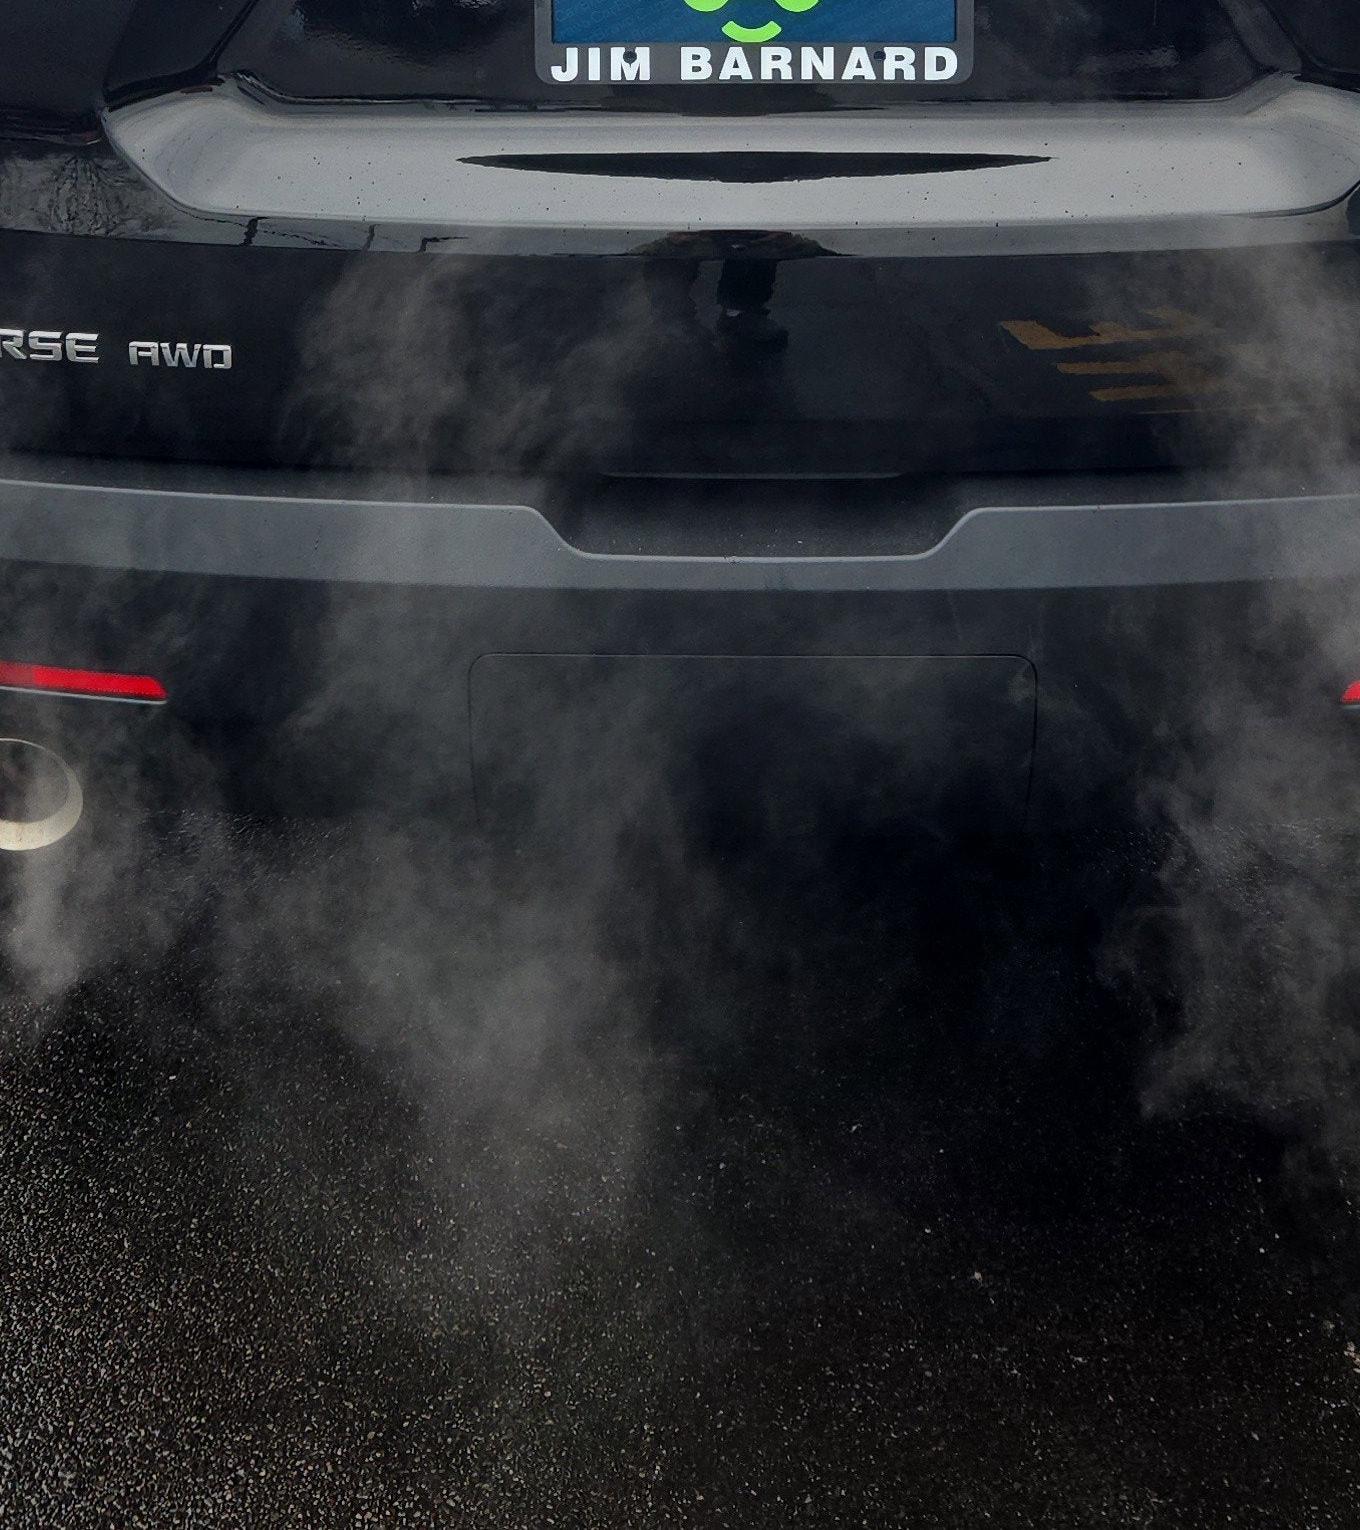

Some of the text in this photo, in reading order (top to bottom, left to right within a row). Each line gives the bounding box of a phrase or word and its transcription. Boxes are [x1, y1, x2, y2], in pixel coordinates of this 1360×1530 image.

[550, 46, 958, 81] JIM BARNARD
[127, 340, 233, 370] AWD
